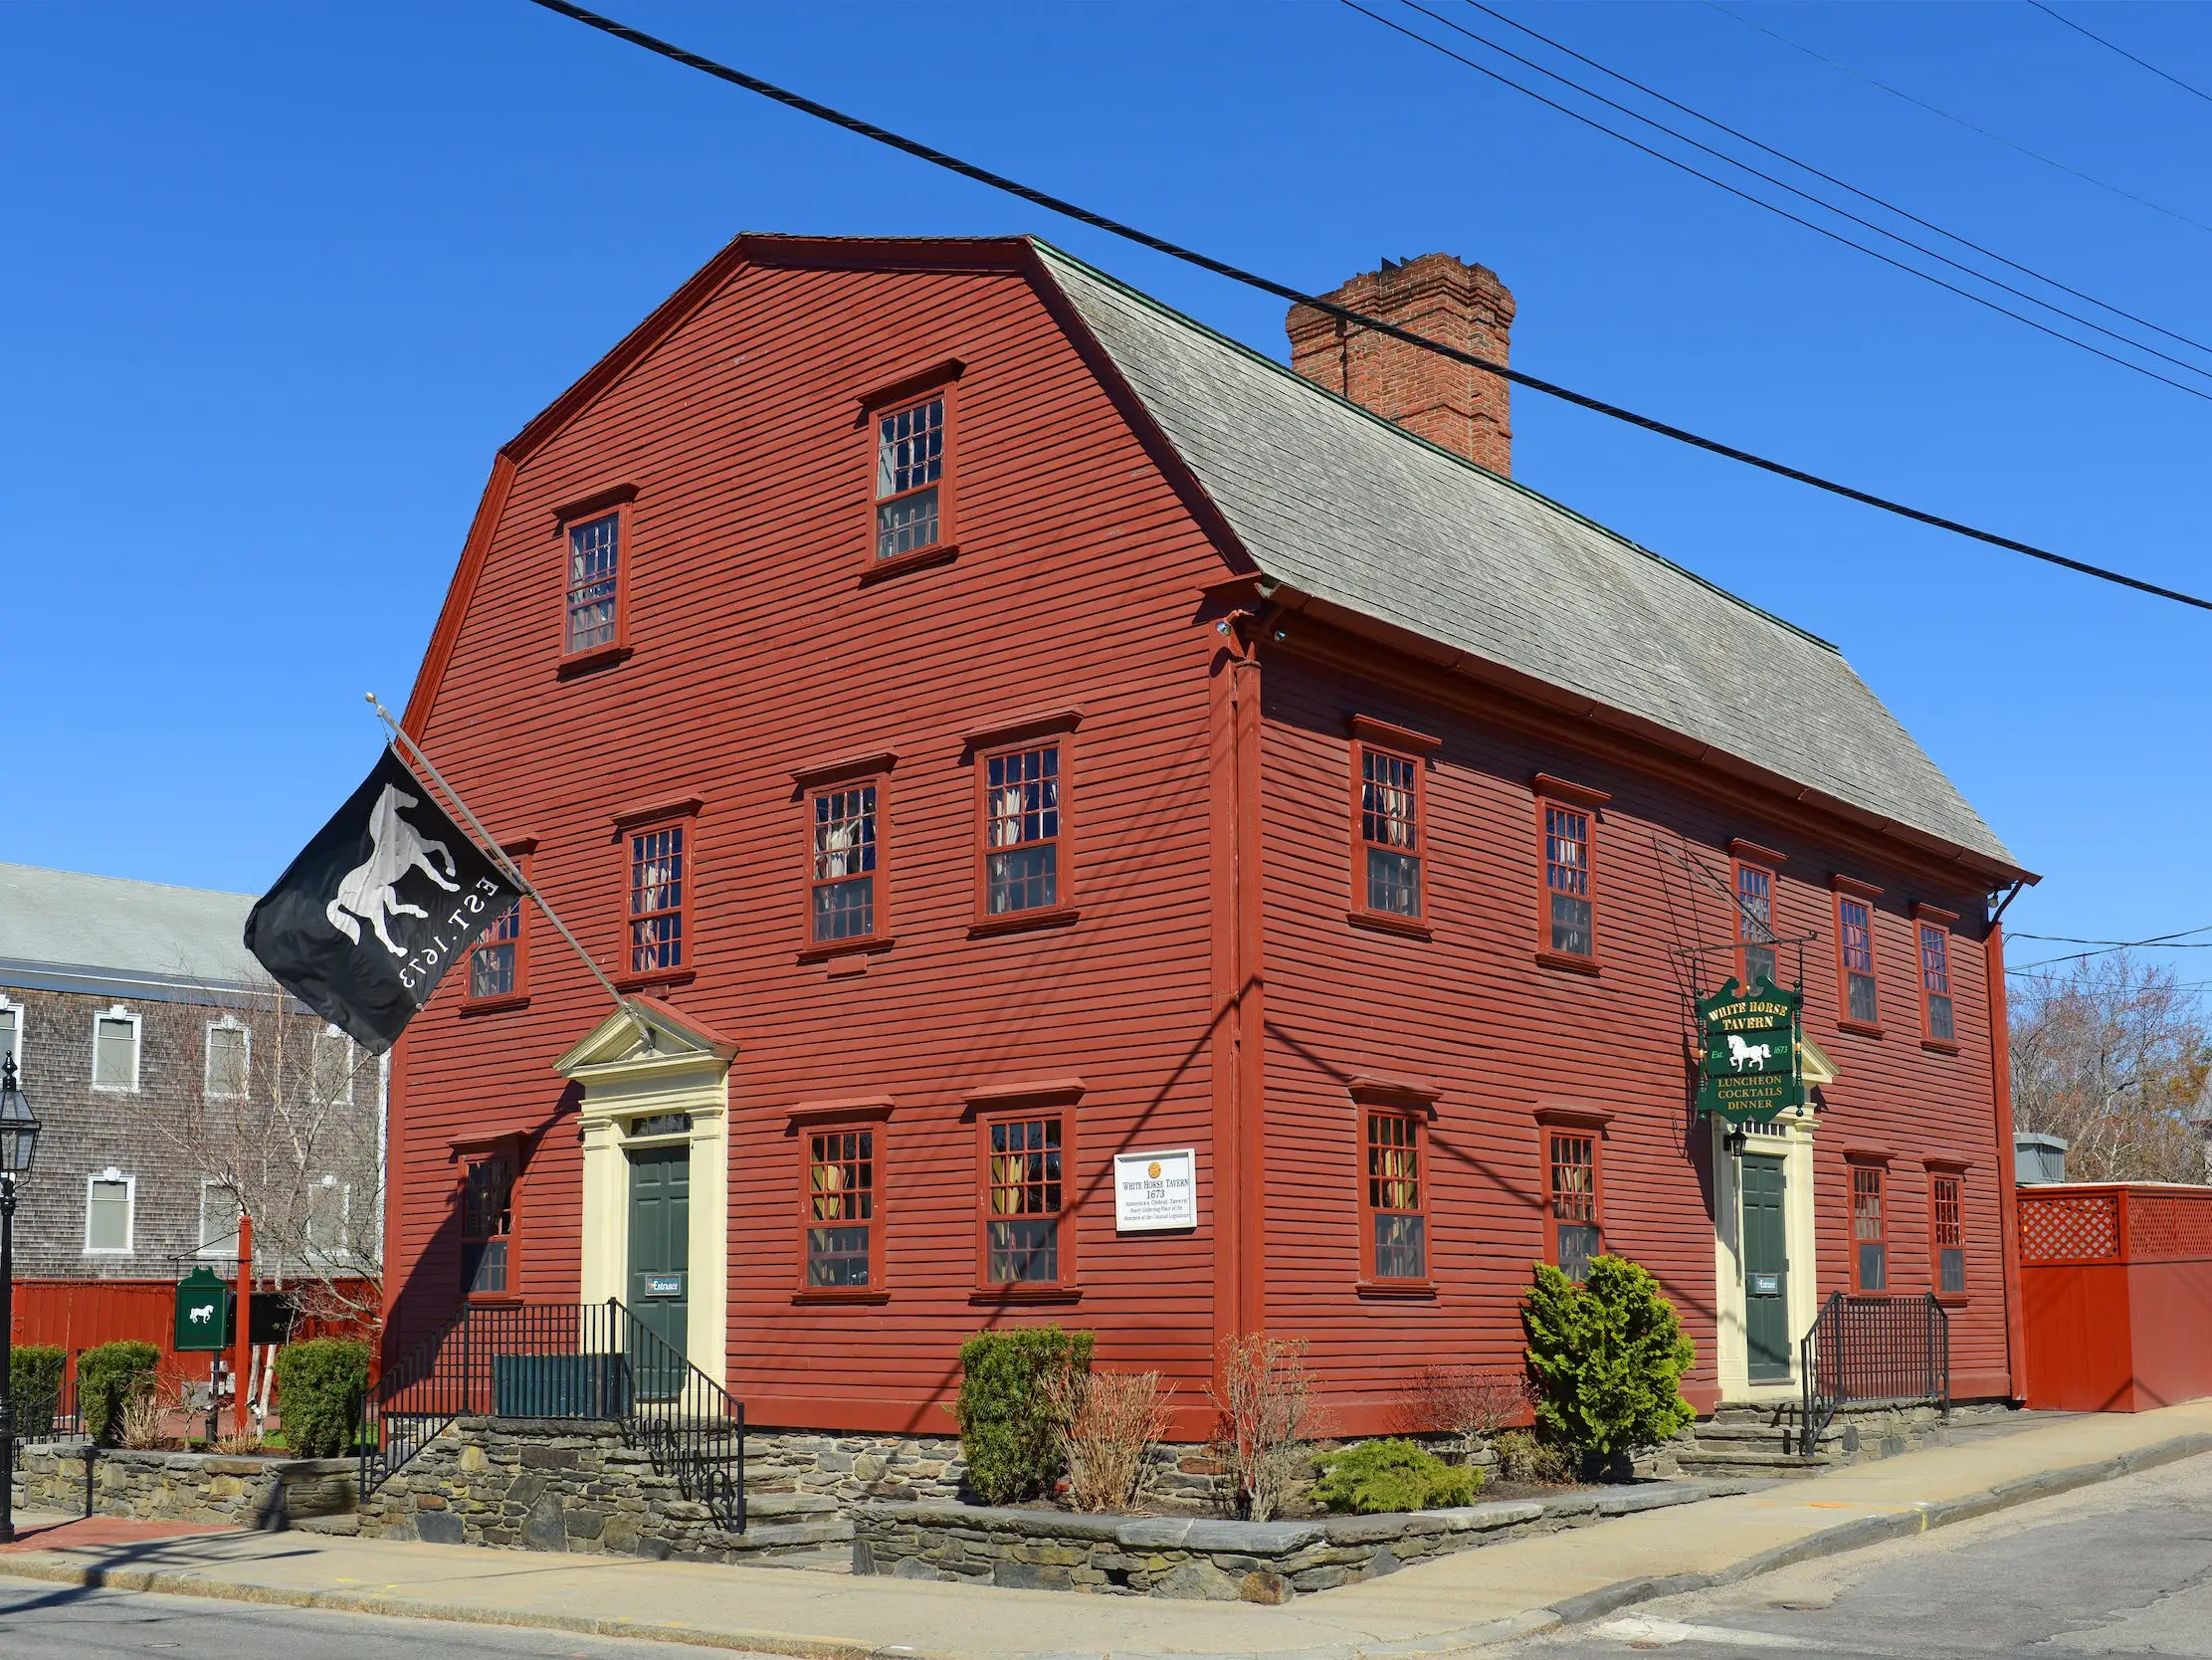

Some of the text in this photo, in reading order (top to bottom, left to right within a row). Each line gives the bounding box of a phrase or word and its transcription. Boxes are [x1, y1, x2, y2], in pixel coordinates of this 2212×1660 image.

[1708, 1001, 1788, 1021] WHITE HORSE
[1722, 1015, 1774, 1030] TAVERN
[1773, 1045, 1788, 1054] 1673
[1717, 1075, 1782, 1088] LUNCHEON
[1717, 1087, 1783, 1099] COCKTAILS
[1727, 1099, 1773, 1111] DINNER
[1123, 1179, 1190, 1190] WHITE HORSE TAVERN
[1146, 1189, 1165, 1199] 1673
[653, 1281, 678, 1290] Entrance
